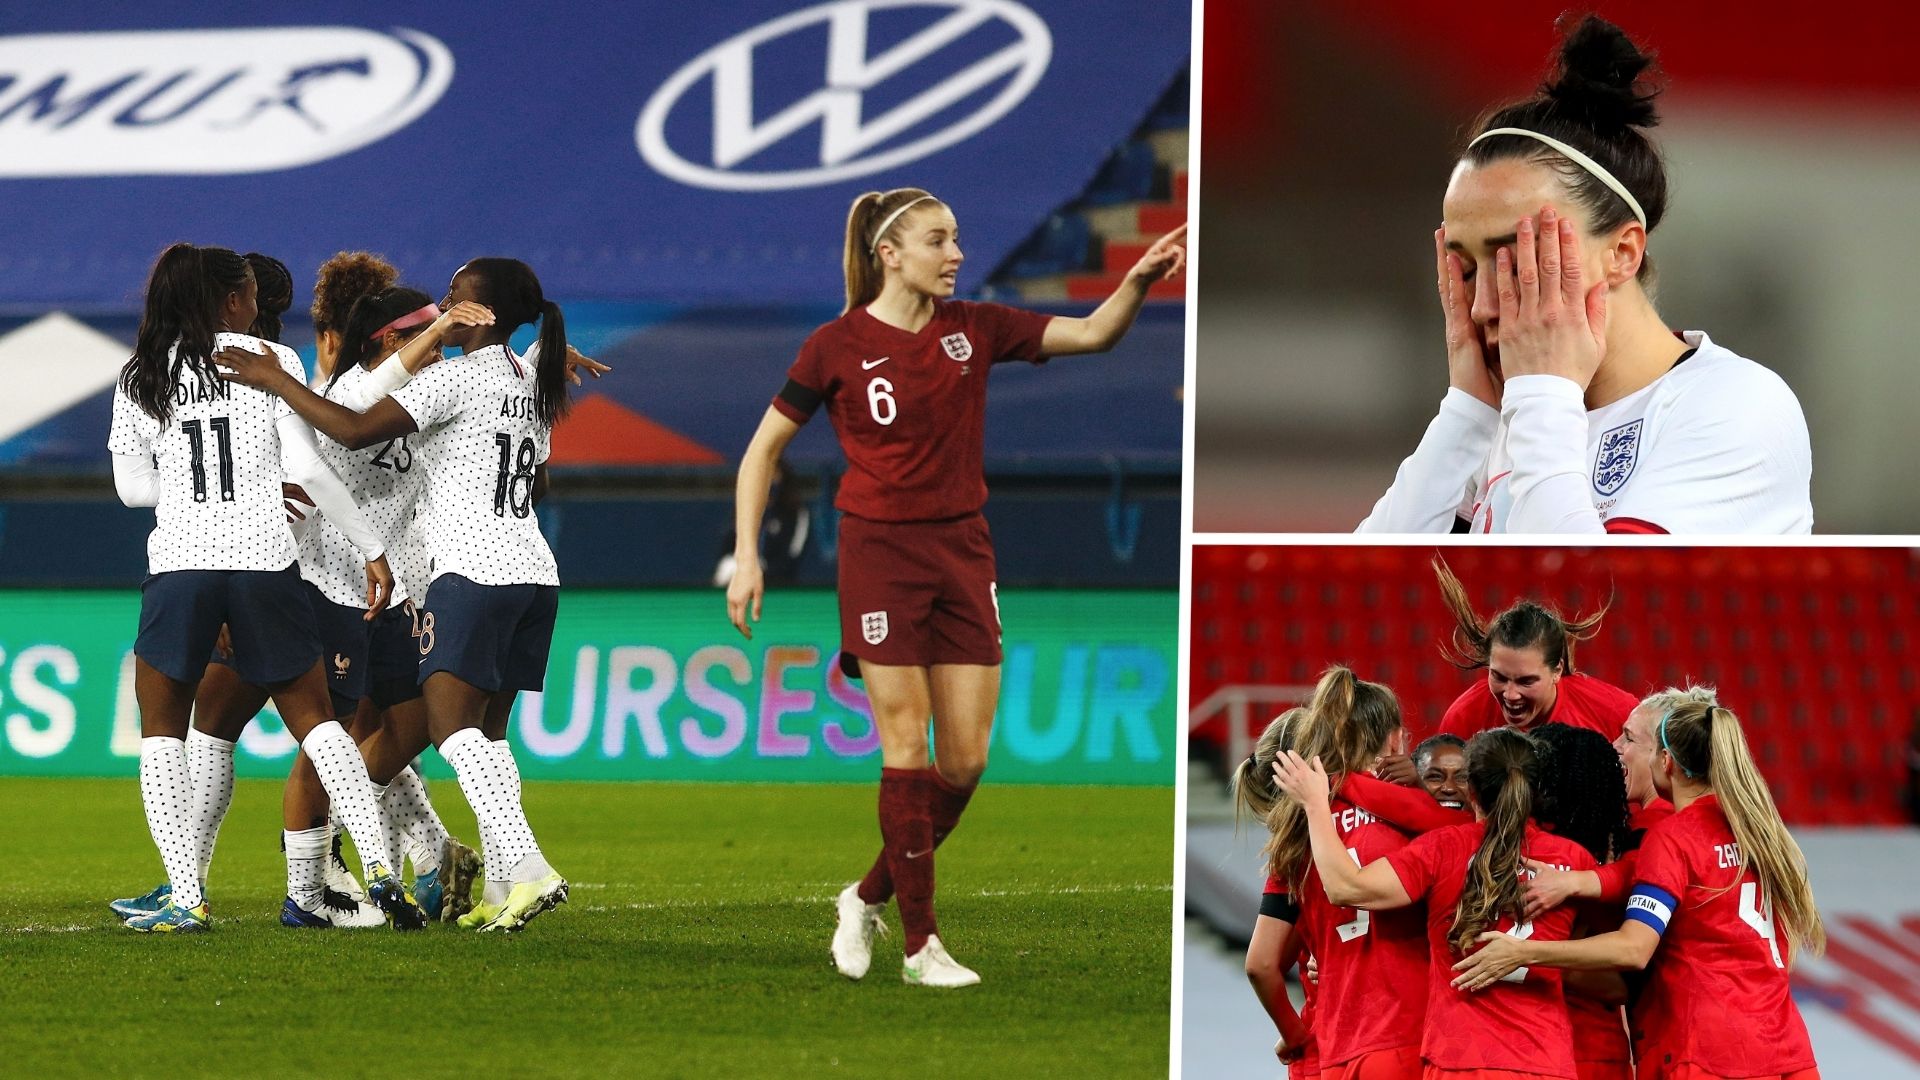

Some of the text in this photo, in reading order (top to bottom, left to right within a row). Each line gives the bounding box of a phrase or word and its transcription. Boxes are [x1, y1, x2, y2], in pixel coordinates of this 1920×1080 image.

[0, 70, 250, 128] MU
[176, 379, 231, 406] DIANI
[500, 394, 536, 421] ASSE
[867, 376, 898, 426] 6
[181, 416, 235, 502] 11
[369, 435, 412, 474] 23
[494, 432, 536, 519] 18
[0, 644, 80, 758] S
[519, 644, 881, 759] URSES
[998, 641, 1169, 765] UR
[1331, 806, 1376, 833] TEM
[1738, 881, 1785, 969] 4
